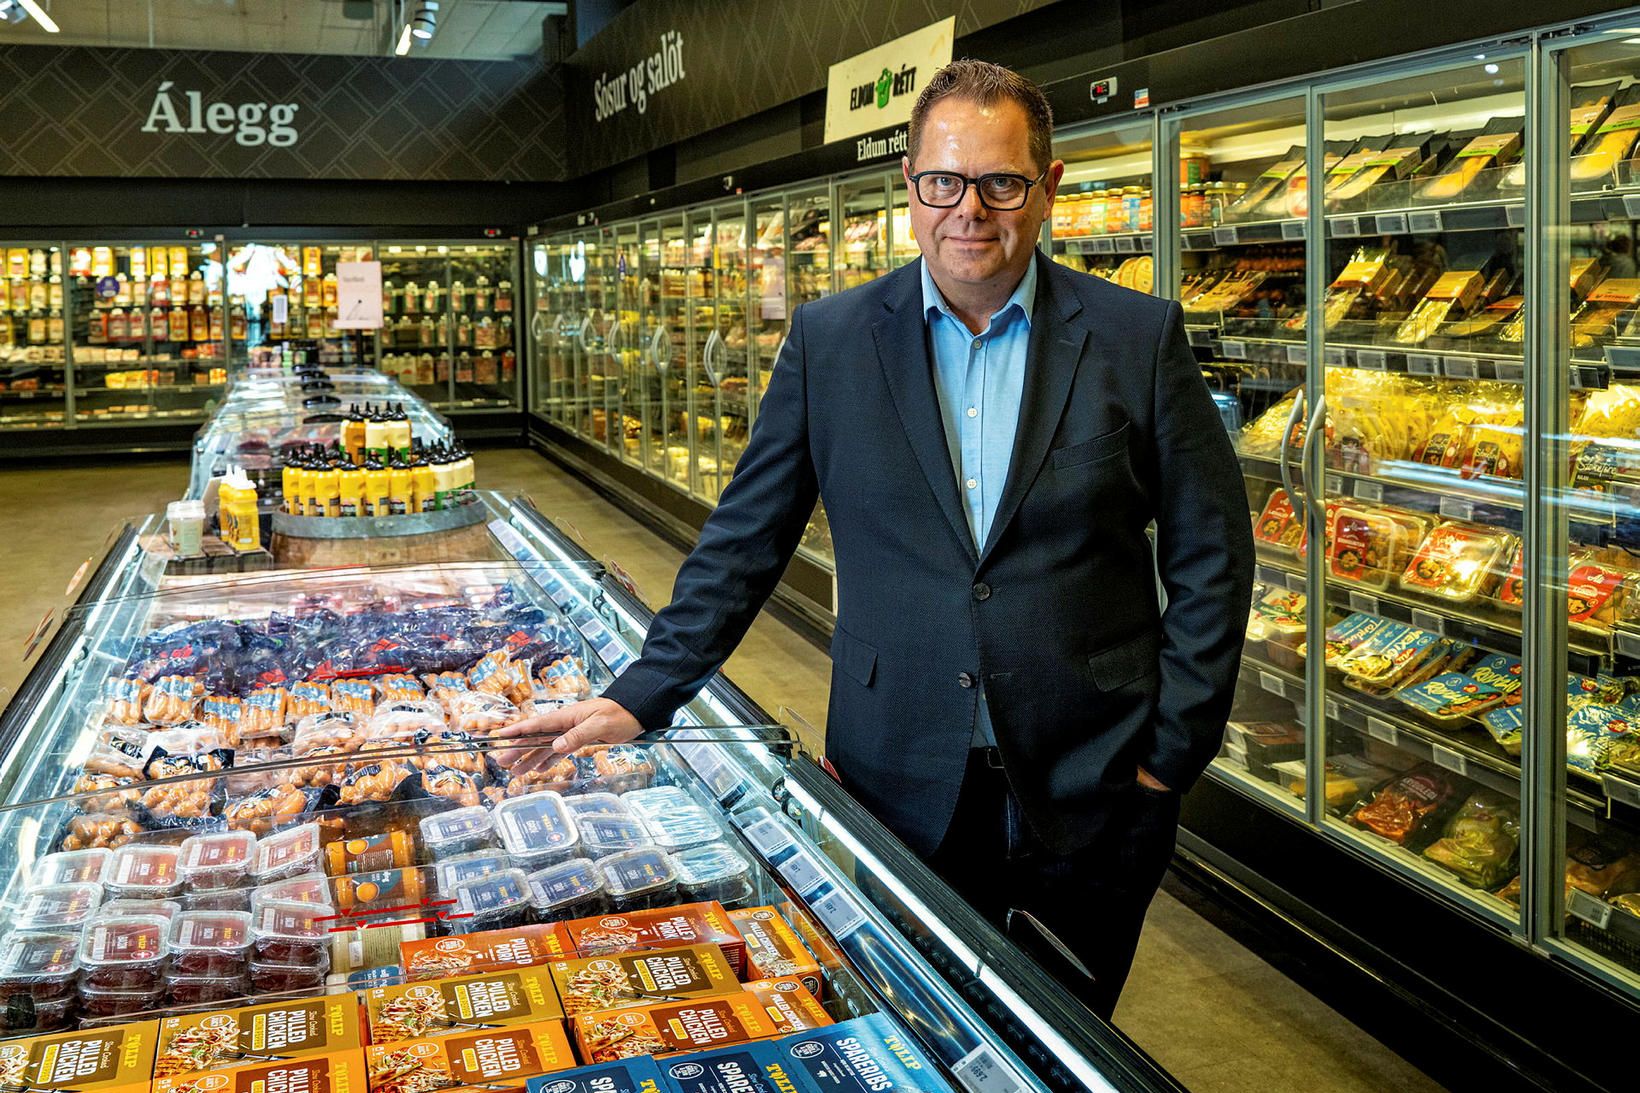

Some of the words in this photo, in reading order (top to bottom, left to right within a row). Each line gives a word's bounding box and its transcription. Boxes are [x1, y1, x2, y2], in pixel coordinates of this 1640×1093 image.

[594, 72, 627, 122] Sósur
[629, 59, 647, 114] og
[646, 29, 686, 95] salöt
[892, 63, 917, 97] RÉTT
[141, 81, 299, 147] Álegg
[857, 136, 887, 161] Eldum
[888, 129, 908, 154] rétt
[655, 922, 677, 940] PORK
[703, 911, 726, 934] TULIP
[509, 937, 533, 965] PULLED
[546, 933, 565, 959] TULIP
[645, 956, 676, 991] CHICKEN
[663, 956, 692, 986] PULLED
[700, 952, 723, 981] TULIP
[468, 981, 493, 1018] CHICKEN
[486, 981, 511, 1012] PULLED
[526, 976, 545, 1007] TULIP
[267, 1010, 287, 1049] CHICKEN
[287, 1009, 307, 1043] PULLED
[329, 1004, 344, 1036] TULIP
[678, 1009, 712, 1045] CHICKEN
[697, 1008, 728, 1039] PULLED
[736, 1003, 762, 1033] TULIP
[53, 1040, 83, 1083] CHICKEN
[76, 1039, 102, 1076] PULLED
[123, 1033, 142, 1068] TULIP
[475, 1039, 503, 1078] CHICKEN
[495, 1038, 521, 1071] PULLED
[539, 1033, 557, 1064] TULIP
[835, 1037, 892, 1091] SPARERIBS
[884, 1034, 922, 1070] TULIP
